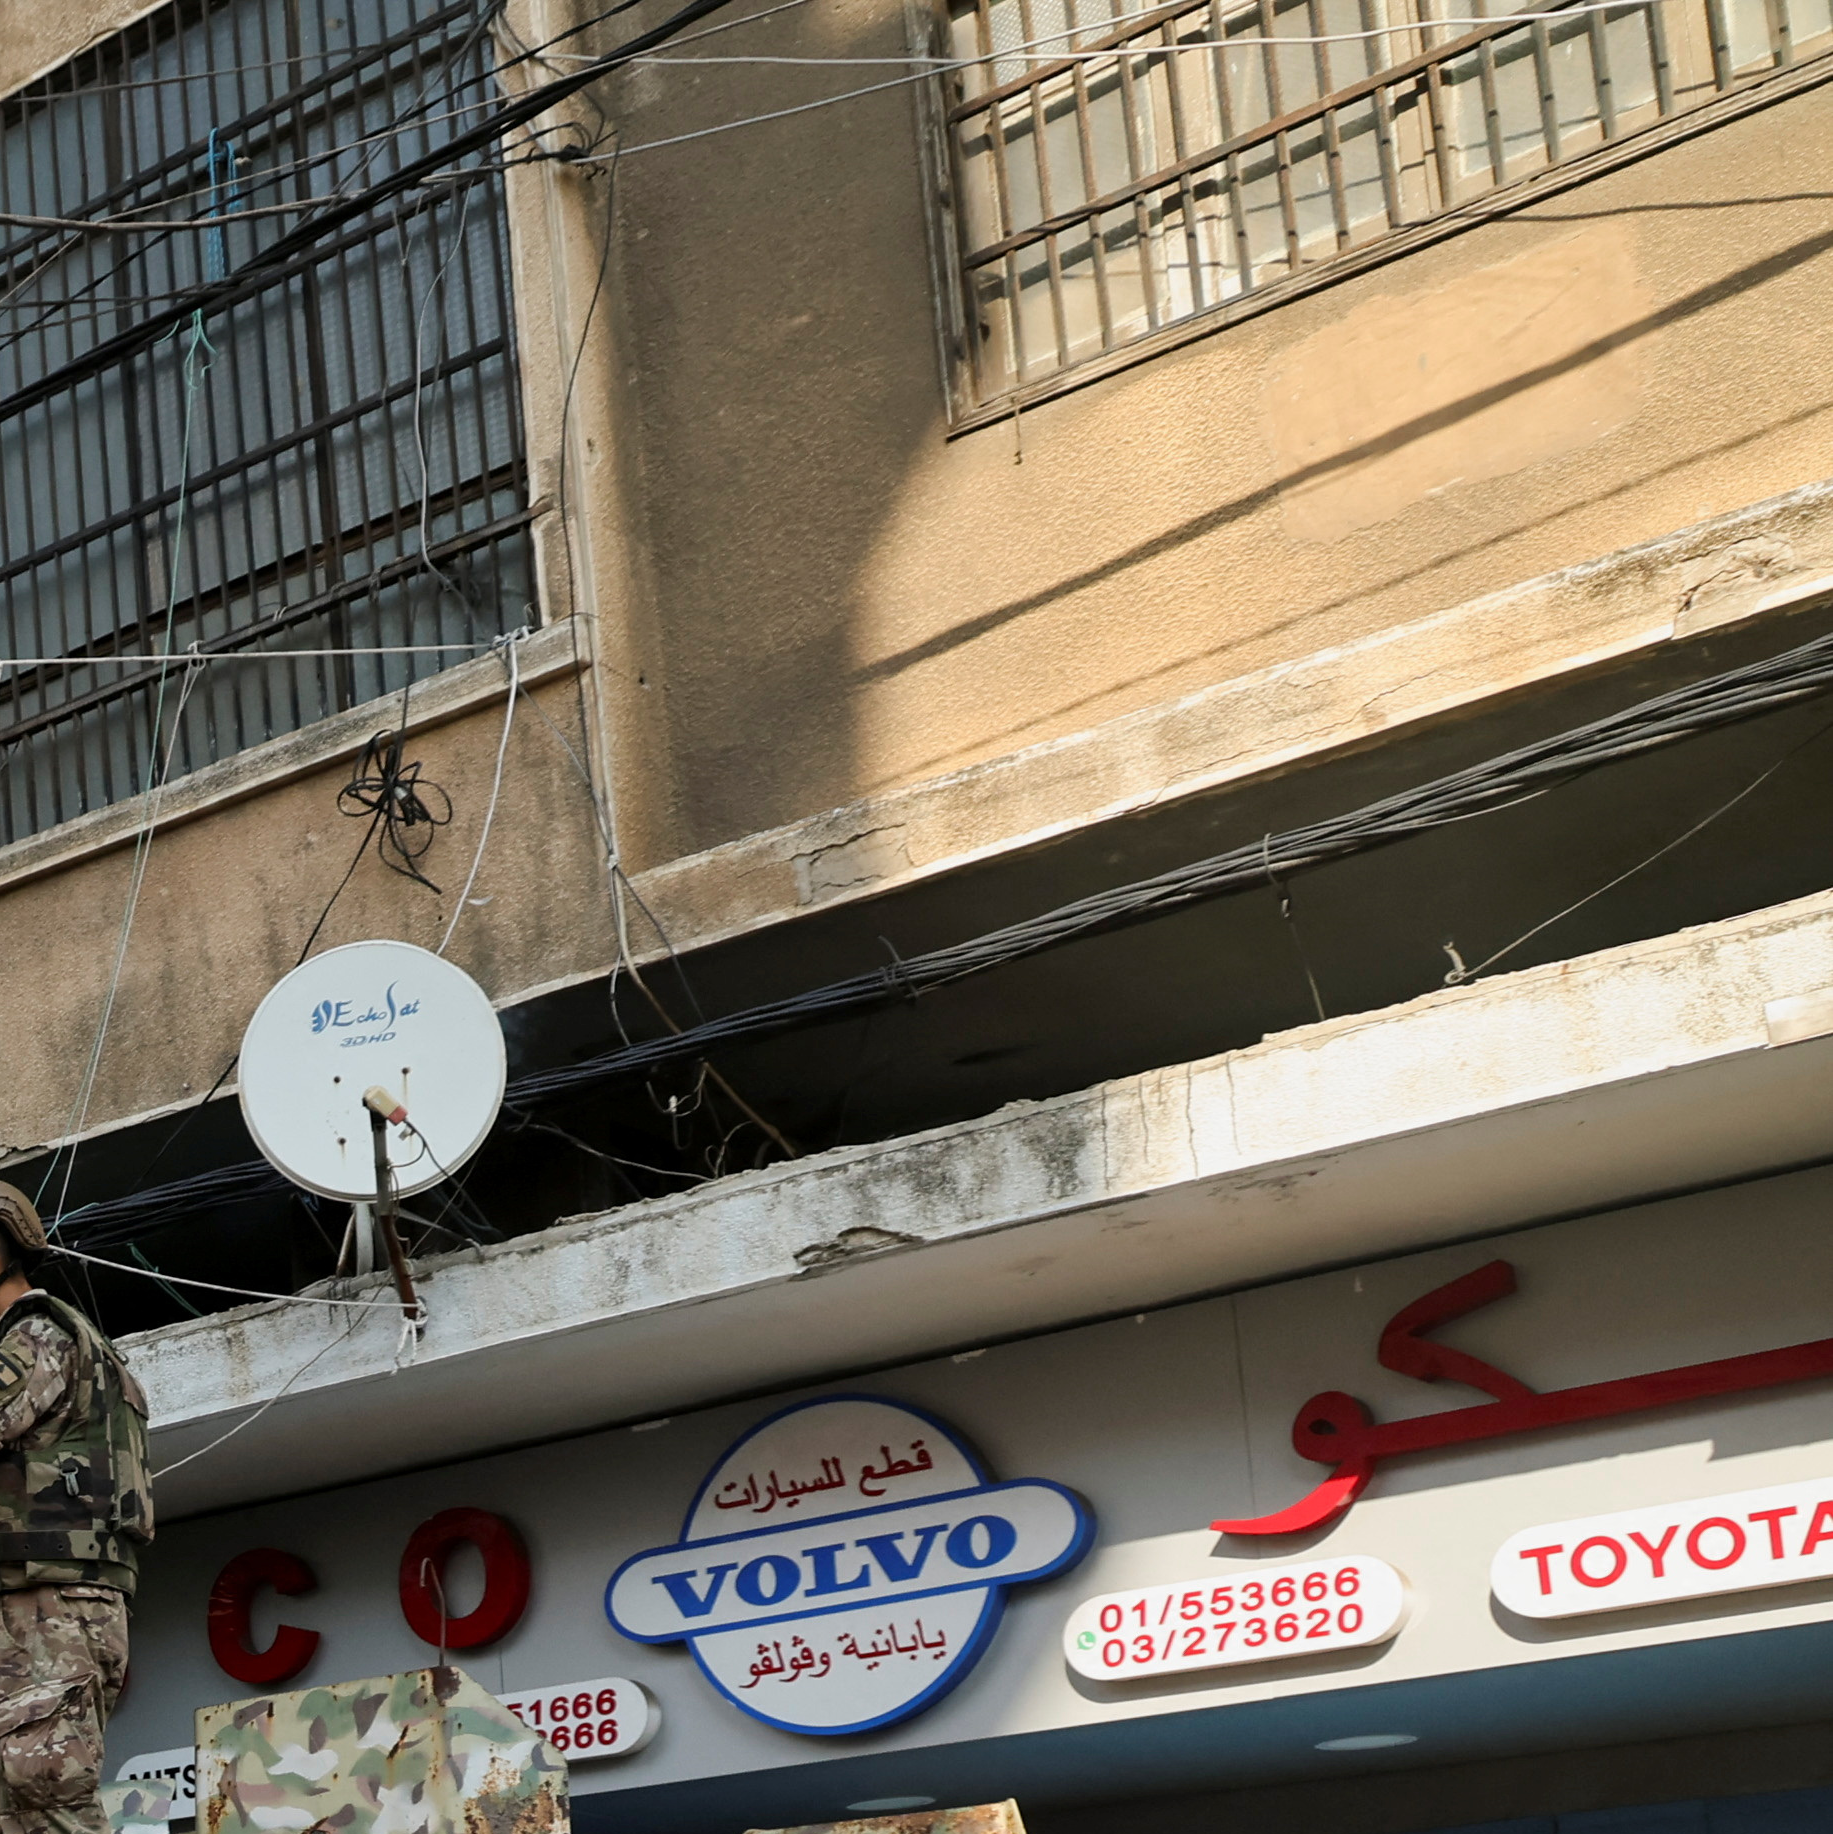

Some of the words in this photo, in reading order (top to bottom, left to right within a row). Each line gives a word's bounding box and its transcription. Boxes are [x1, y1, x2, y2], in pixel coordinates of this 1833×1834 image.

[713, 1457, 846, 1514] للسيارات
[859, 1438, 934, 1496] قطع
[651, 1515, 1017, 1619] VOLVO
[1099, 1566, 1360, 1633] 01/553666
[836, 1619, 948, 1672] يابانية
[1102, 1603, 1364, 1668] 03/273620
[535, 1718, 619, 1751] 666
